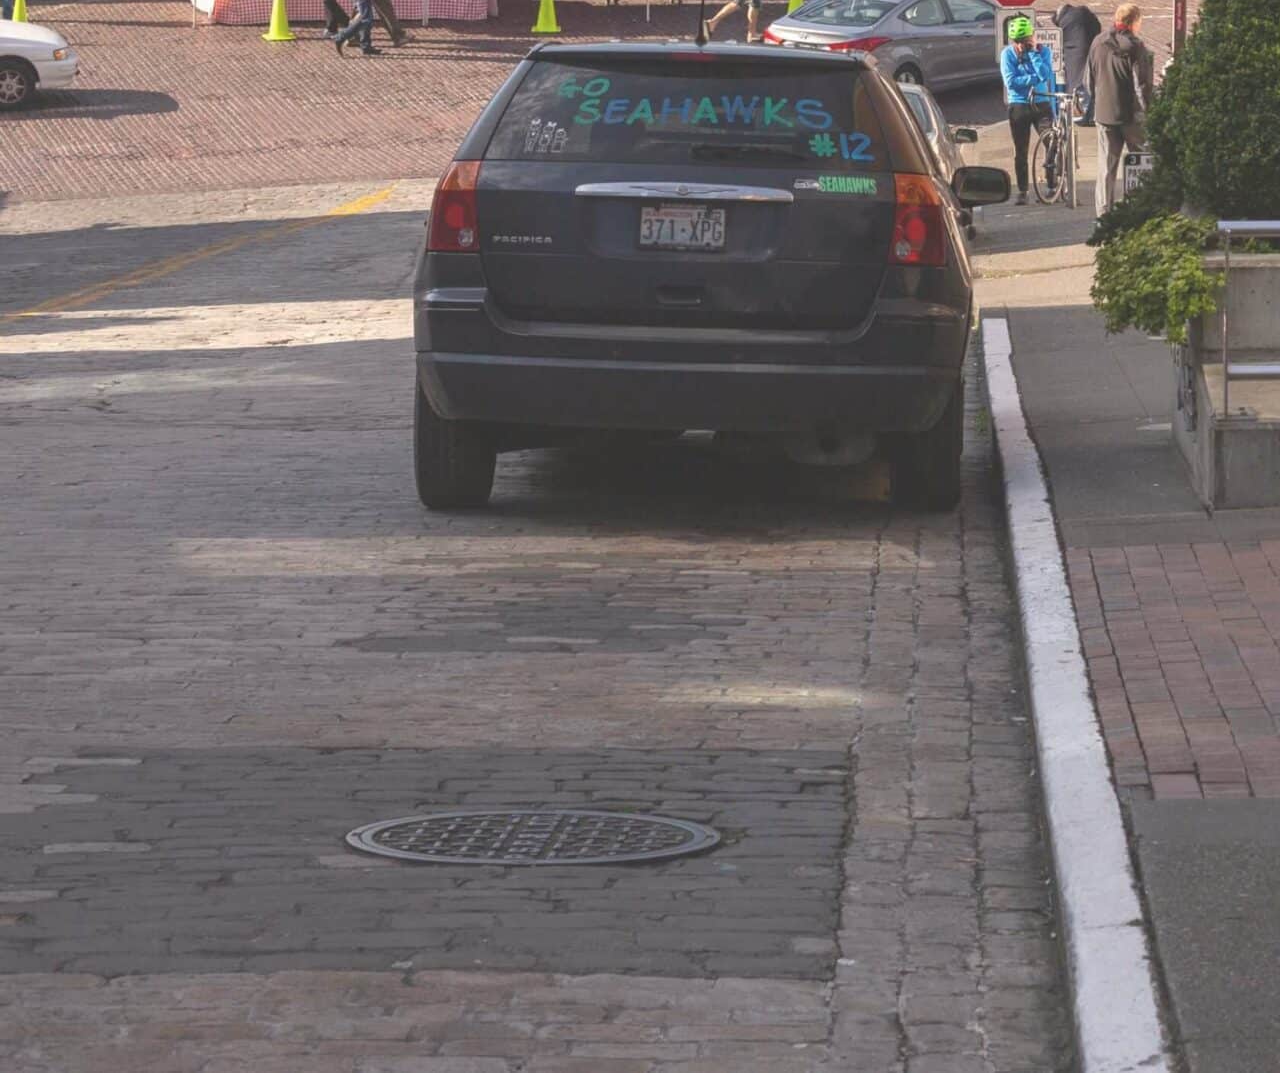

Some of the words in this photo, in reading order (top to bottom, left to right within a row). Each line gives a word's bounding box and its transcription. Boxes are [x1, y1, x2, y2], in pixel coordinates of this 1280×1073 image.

[557, 77, 610, 97] GO
[573, 94, 833, 129] SEAHAWKS
[809, 132, 875, 161] #12
[818, 176, 877, 194] SEAHAWKS
[492, 235, 553, 244] PACIFICA
